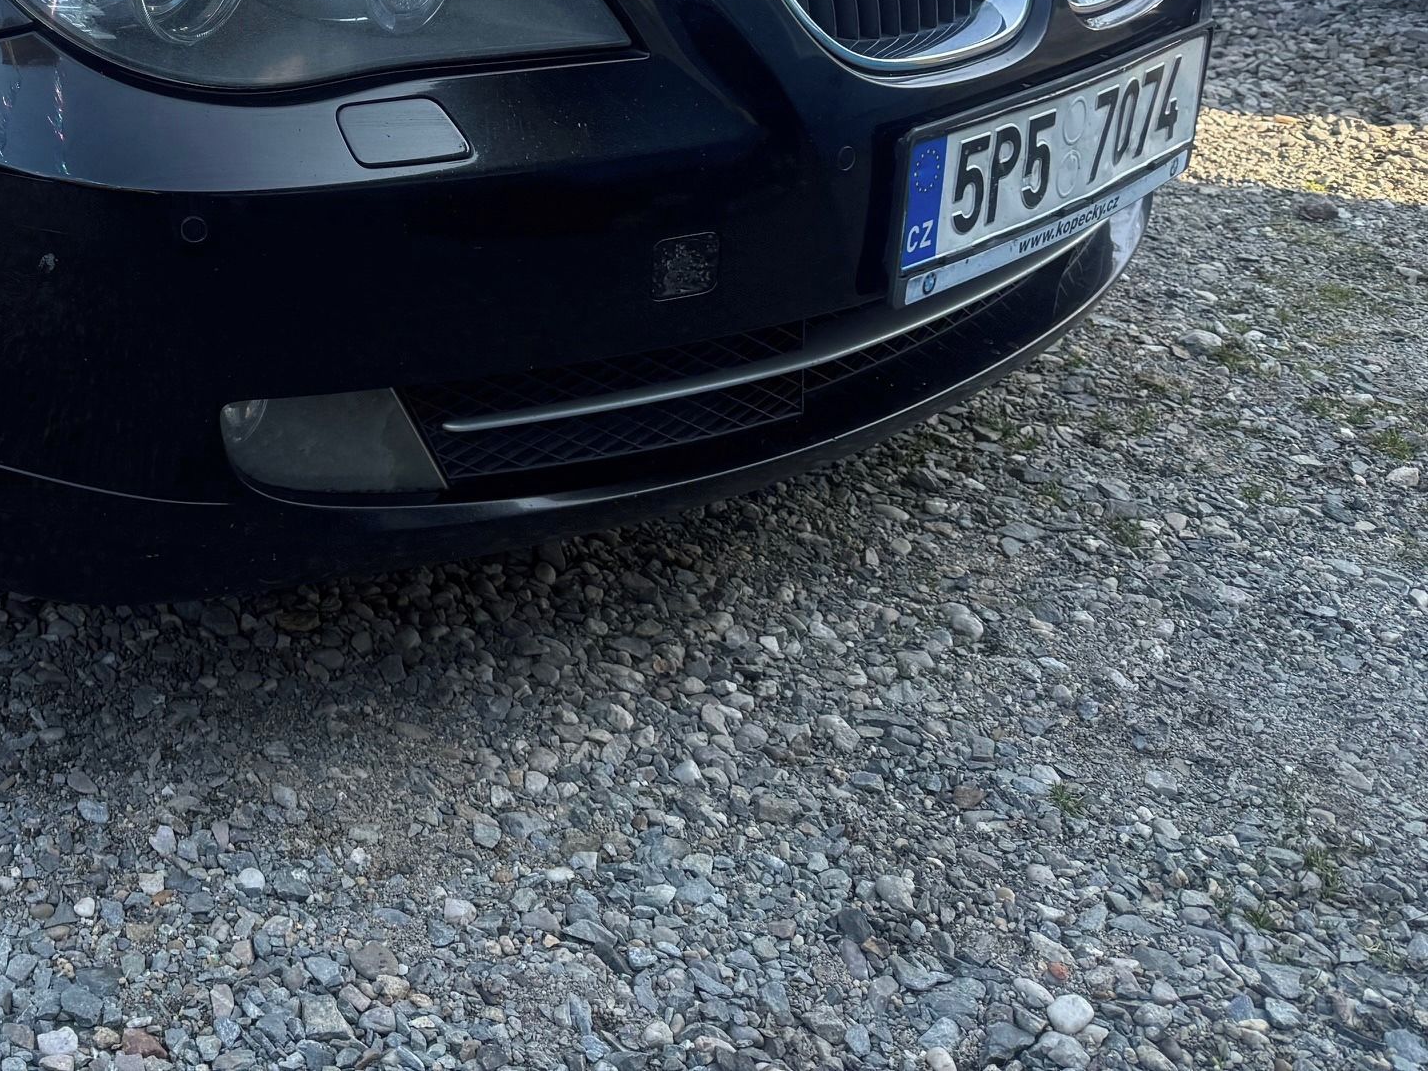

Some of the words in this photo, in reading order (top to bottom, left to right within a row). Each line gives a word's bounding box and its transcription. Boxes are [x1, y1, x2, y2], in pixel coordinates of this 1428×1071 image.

[951, 108, 1058, 235] 5P5
[1086, 54, 1183, 185] 7074
[906, 219, 934, 253] CZ
[1018, 195, 1120, 254] www.kopecky.cz
